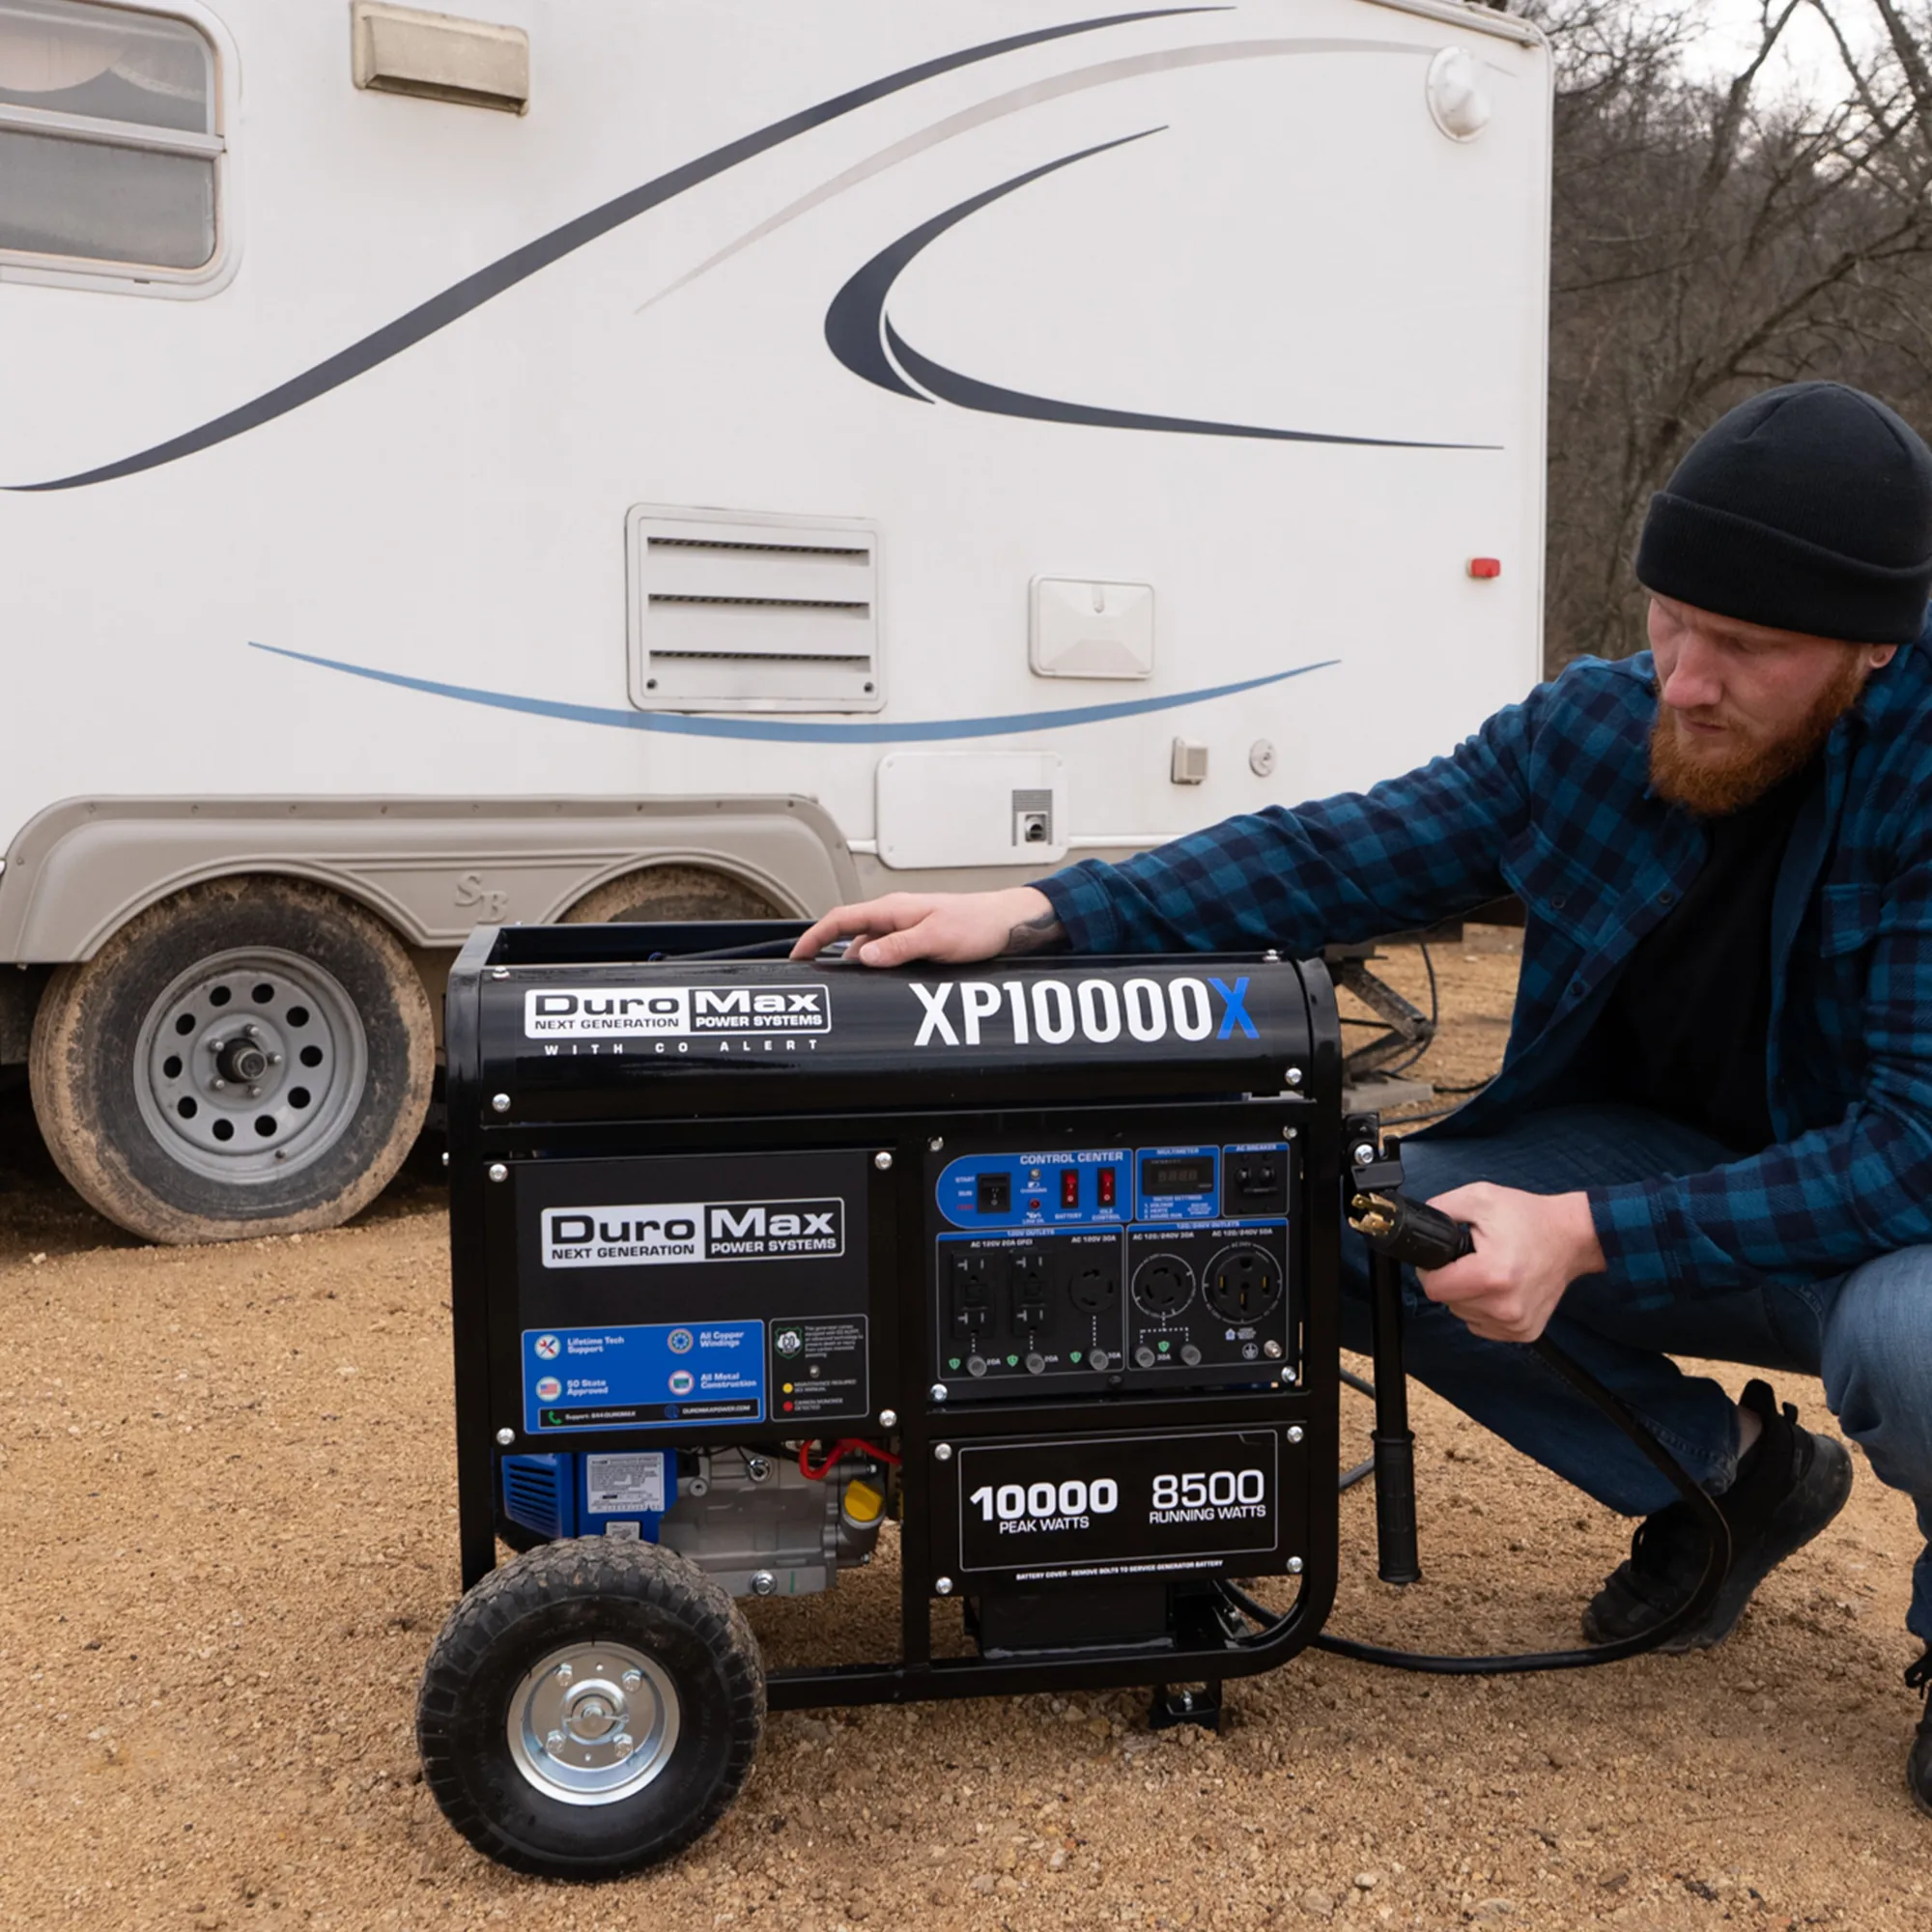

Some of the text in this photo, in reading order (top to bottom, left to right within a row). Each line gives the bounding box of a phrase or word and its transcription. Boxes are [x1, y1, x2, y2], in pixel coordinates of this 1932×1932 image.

[908, 977, 1260, 1047] XP10000X
[534, 1017, 680, 1031] NEXT GENERATION
[695, 1013, 823, 1029] POWER SYSTEMS
[544, 1038, 818, 1056] WITH CO ALERT
[1019, 1151, 1123, 1165] CONTROL CENTER
[1156, 1147, 1200, 1155] MULTIMETER
[551, 1244, 696, 1260] NEXT GENERATION
[711, 1237, 837, 1255] POWER SYSTEMS
[567, 1335, 625, 1346] Lifetime Tech
[699, 1330, 745, 1341] All Copper
[567, 1345, 604, 1354] Support
[699, 1339, 741, 1349] Windings
[986, 1357, 1001, 1366] 20A
[566, 1378, 607, 1388] 50 State
[700, 1371, 741, 1381] All Metal
[700, 1379, 757, 1389] Construction
[566, 1386, 609, 1397] Approved
[1151, 1468, 1264, 1509] 8500
[970, 1478, 1119, 1520] 10000
[1149, 1504, 1266, 1524] RUNNING WATTS
[999, 1516, 1090, 1534] PEAK WATTS
[1015, 1572, 1045, 1580] BATTERY
[1045, 1570, 1067, 1579] COVER
[1071, 1568, 1098, 1577] REMOVE
[1129, 1564, 1156, 1574] SERVICE
[1156, 1561, 1195, 1572] GENERATOR
[1195, 1559, 1223, 1569] BATTERY
